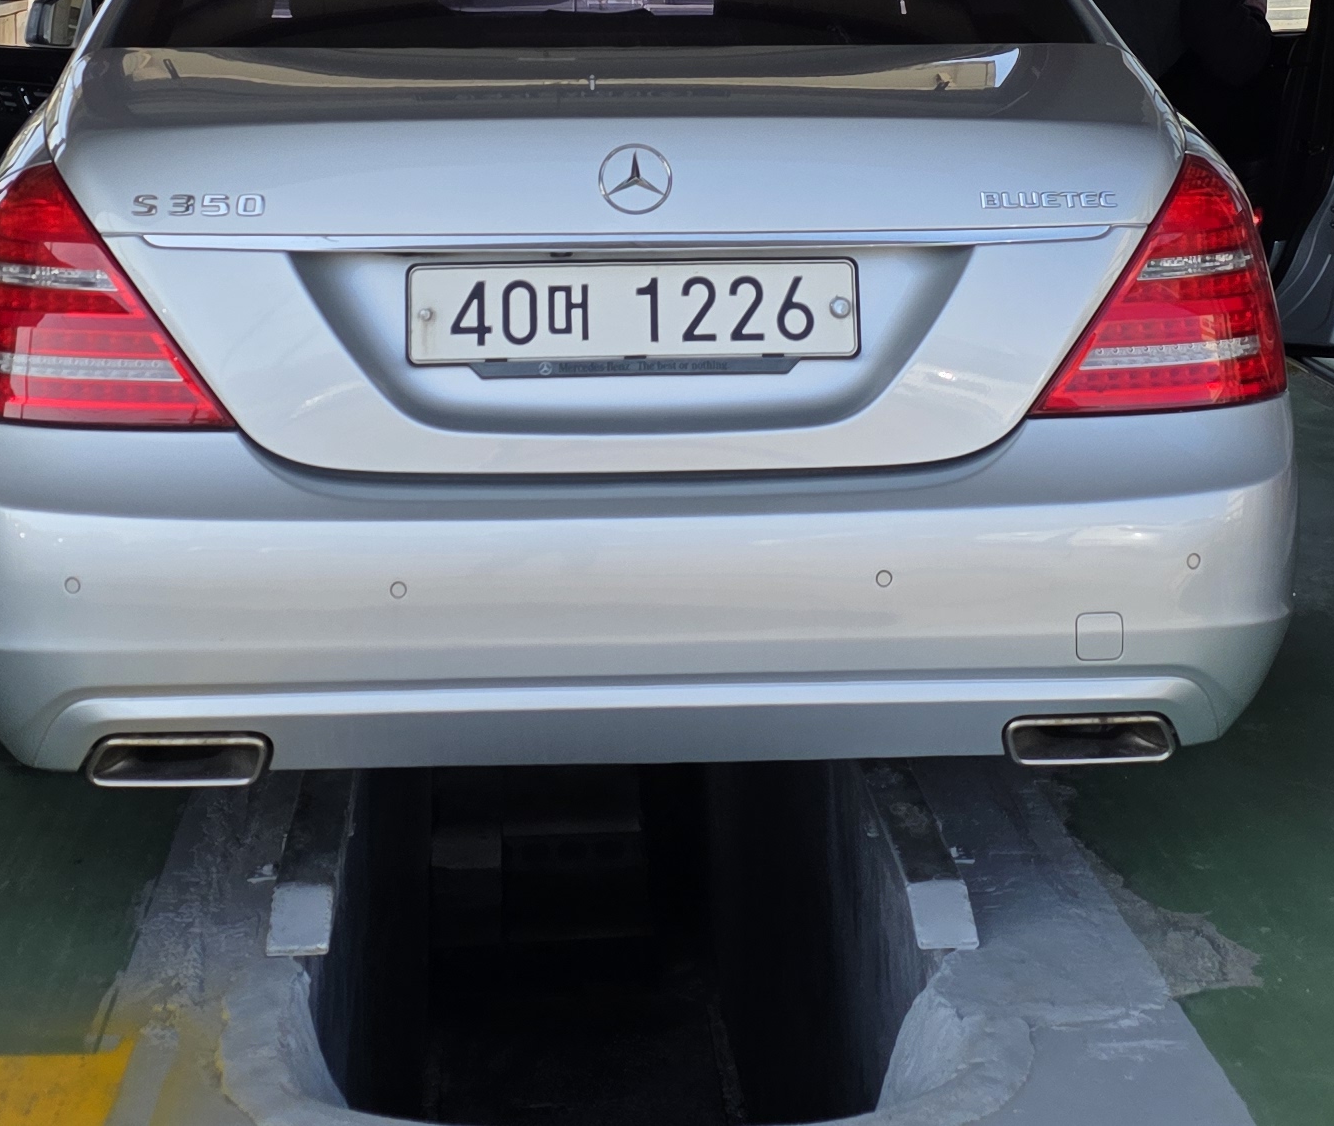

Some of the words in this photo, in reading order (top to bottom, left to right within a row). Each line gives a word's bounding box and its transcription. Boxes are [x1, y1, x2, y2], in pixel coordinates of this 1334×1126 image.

[131, 193, 159, 217] S
[167, 193, 266, 217] 350
[979, 191, 1118, 209] BLUETEC
[450, 279, 590, 347] 40머
[635, 275, 815, 343] 1226
[558, 361, 630, 373] Mercedes-Benz
[637, 361, 655, 372] The
[656, 361, 677, 371] best
[678, 362, 689, 371] or
